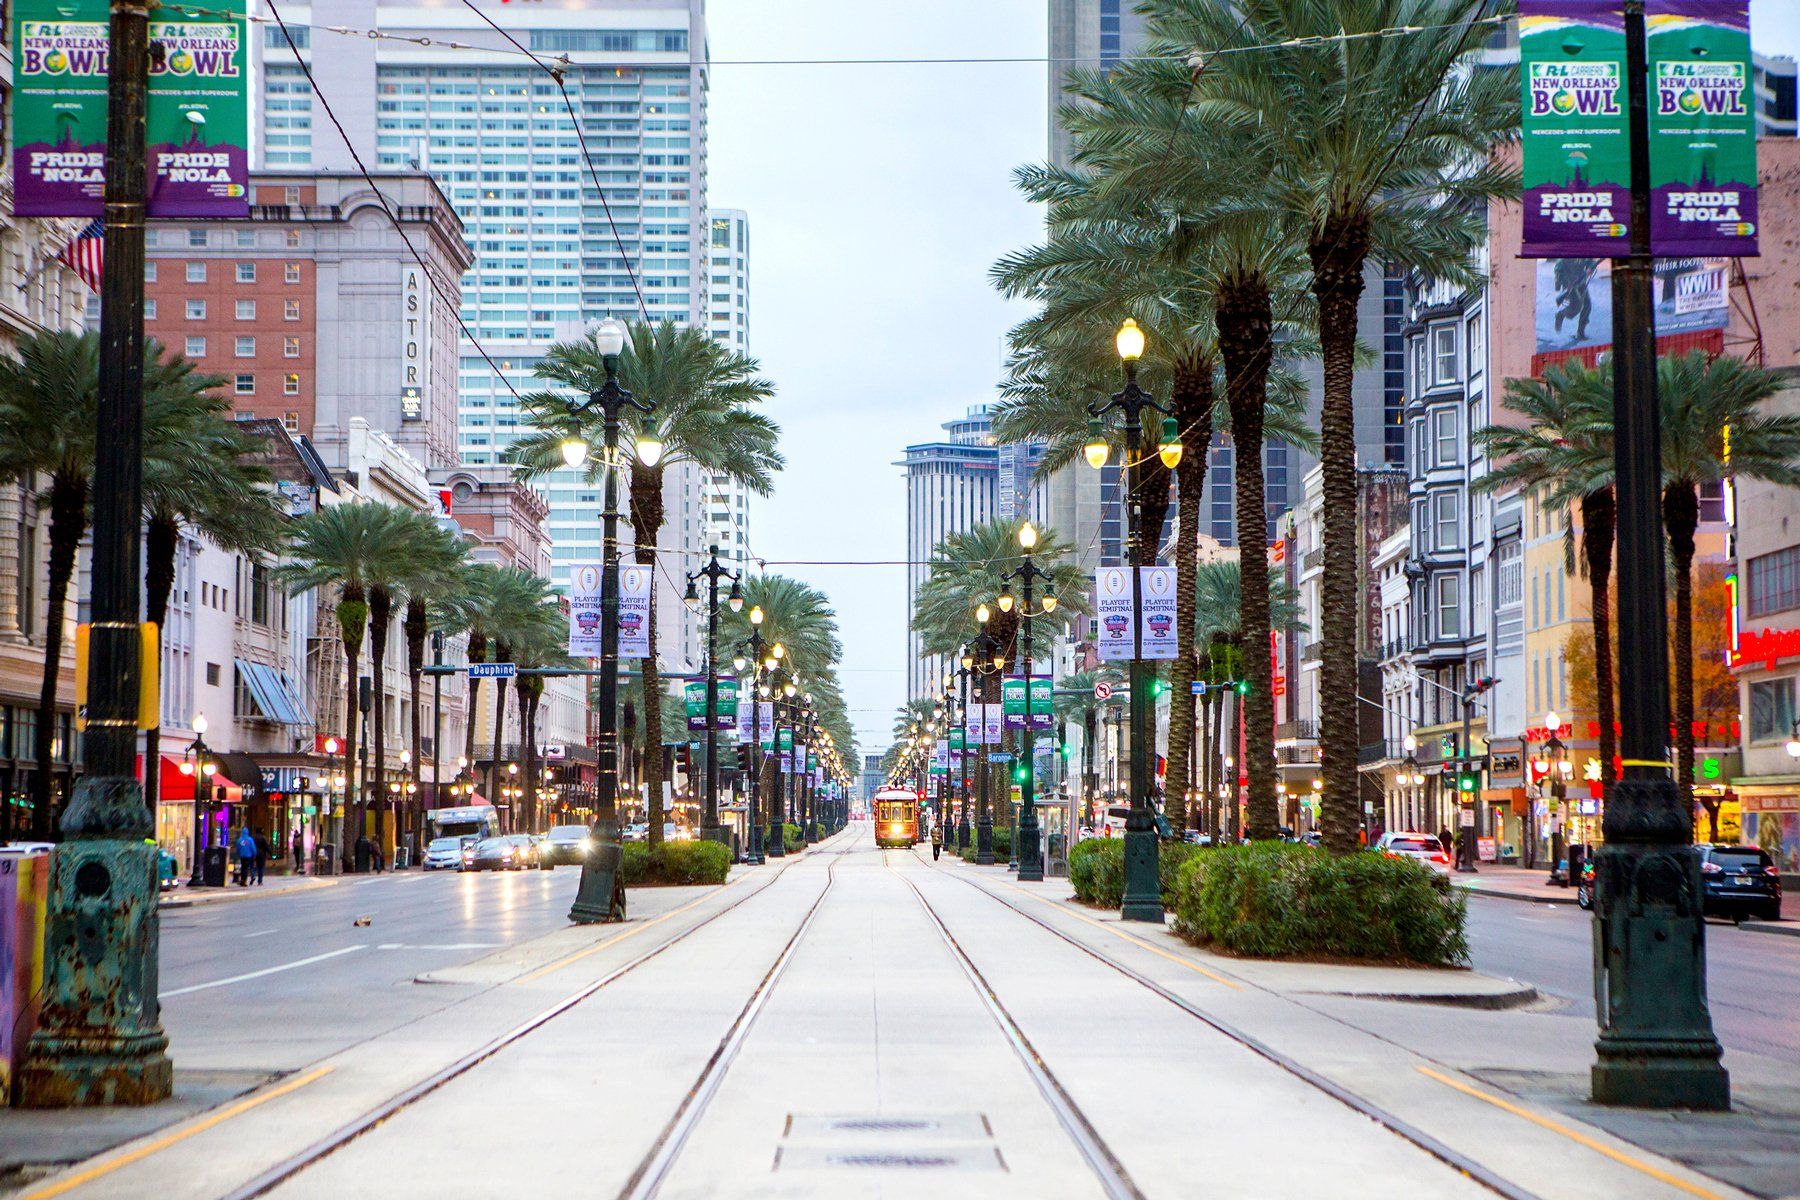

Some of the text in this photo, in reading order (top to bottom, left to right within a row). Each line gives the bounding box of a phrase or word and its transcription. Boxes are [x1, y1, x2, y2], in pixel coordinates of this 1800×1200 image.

[24, 38, 53, 49] NEW
[181, 39, 236, 50] ORLEANS
[24, 49, 109, 74] BOWL
[1533, 78, 1618, 89] NEW ORLEANS
[1660, 77, 1743, 89] NEW ORLEANS
[1533, 89, 1619, 114] BOWL
[1660, 89, 1744, 113] BOWL
[30, 152, 104, 167] PRIDE
[157, 153, 230, 168] PRIDE
[43, 168, 106, 182] NOLA
[169, 168, 232, 183] NOLA
[1540, 192, 1613, 208] PRIDE
[1667, 191, 1740, 207] PRIDE
[1552, 208, 1614, 223] NOLA
[1679, 207, 1742, 222] NOLA
[1680, 271, 1722, 297] WWII
[407, 272, 418, 383] ASTOR
[474, 665, 514, 676] Dauphine
